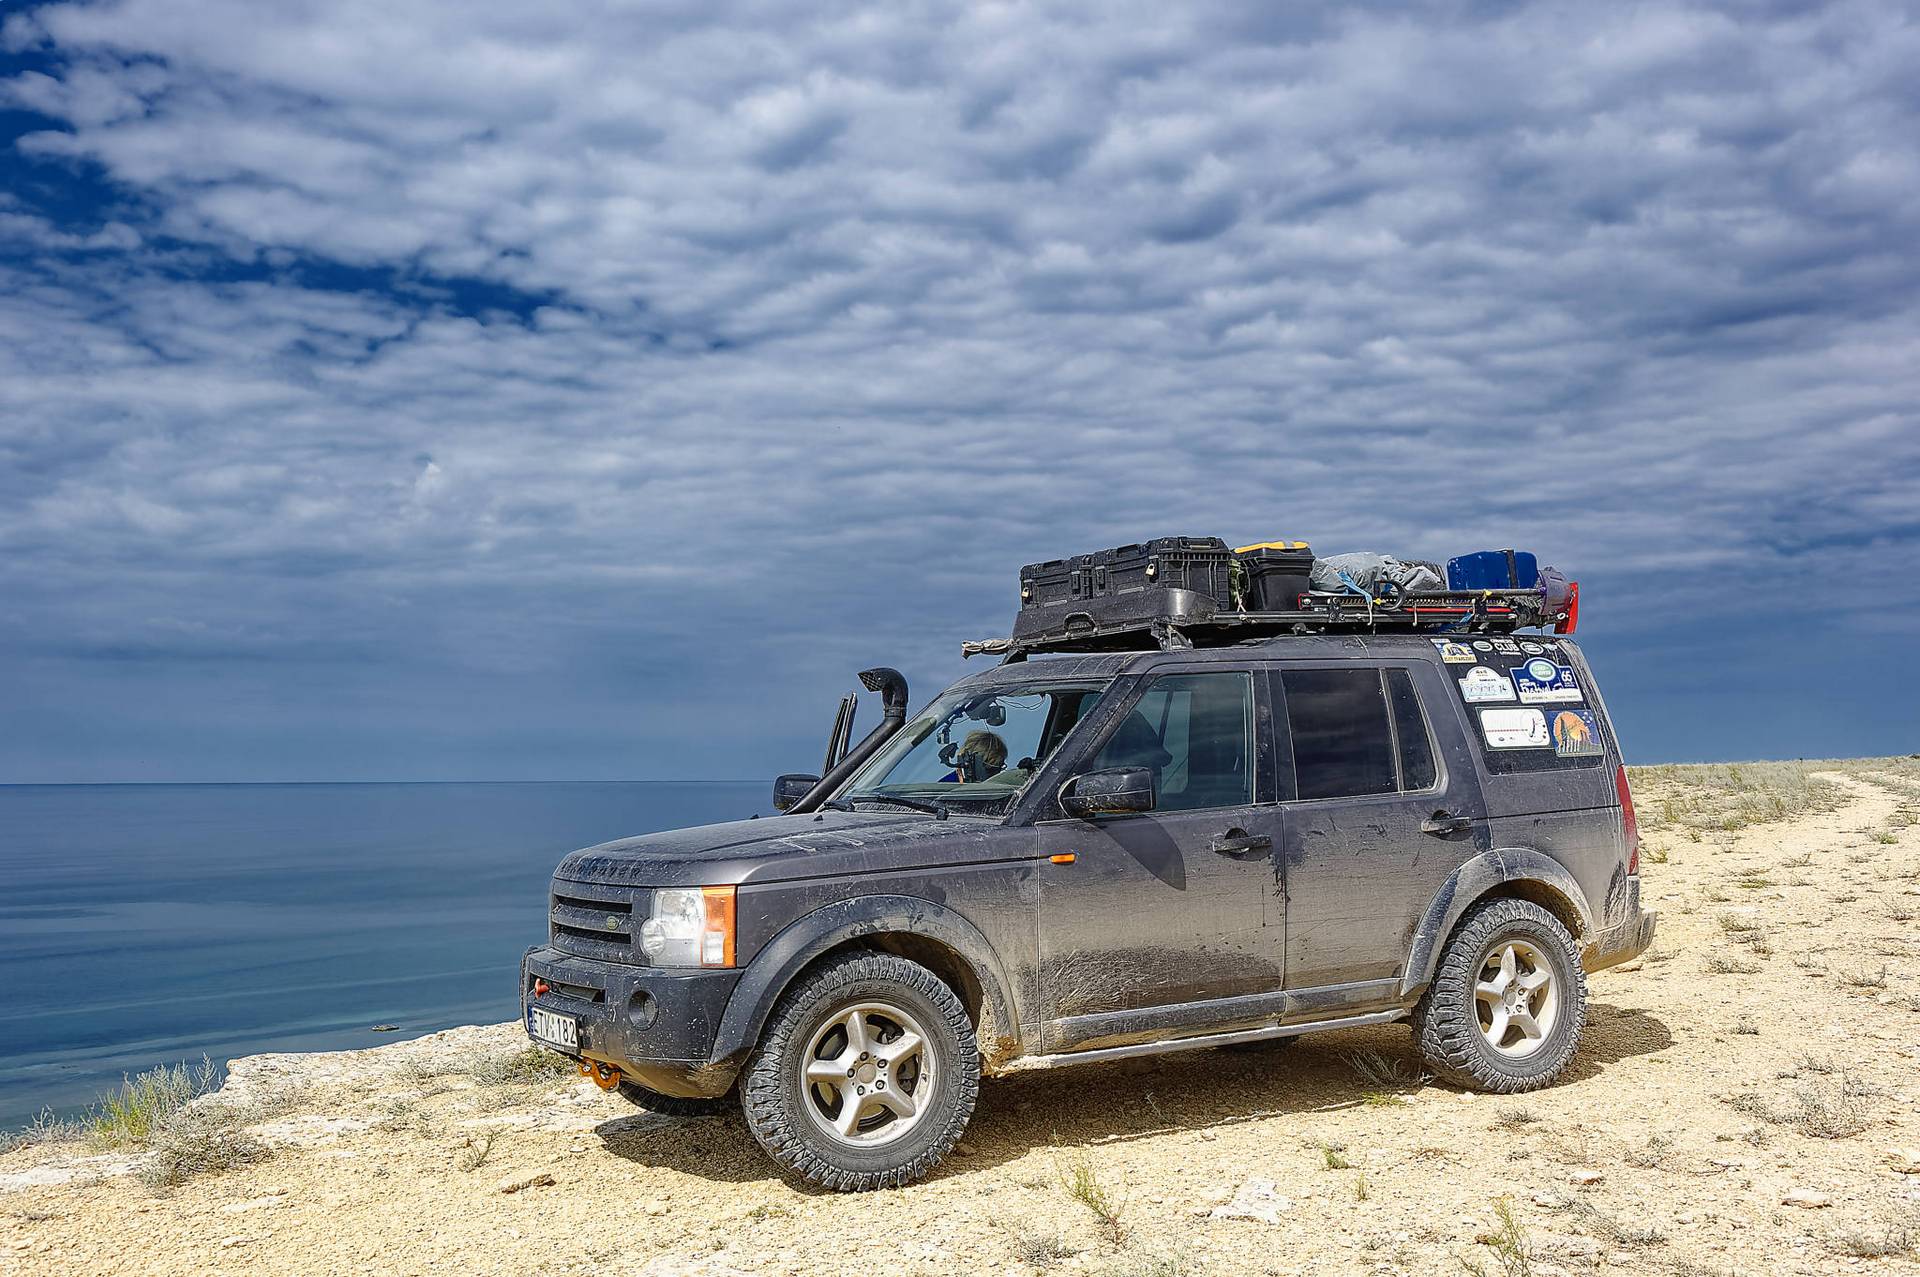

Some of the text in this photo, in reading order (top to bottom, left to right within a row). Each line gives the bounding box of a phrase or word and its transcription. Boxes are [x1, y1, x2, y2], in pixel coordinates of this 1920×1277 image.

[1495, 643, 1520, 651] CLUB
[1561, 670, 1572, 682] 65
[557, 1017, 577, 1046] 182
